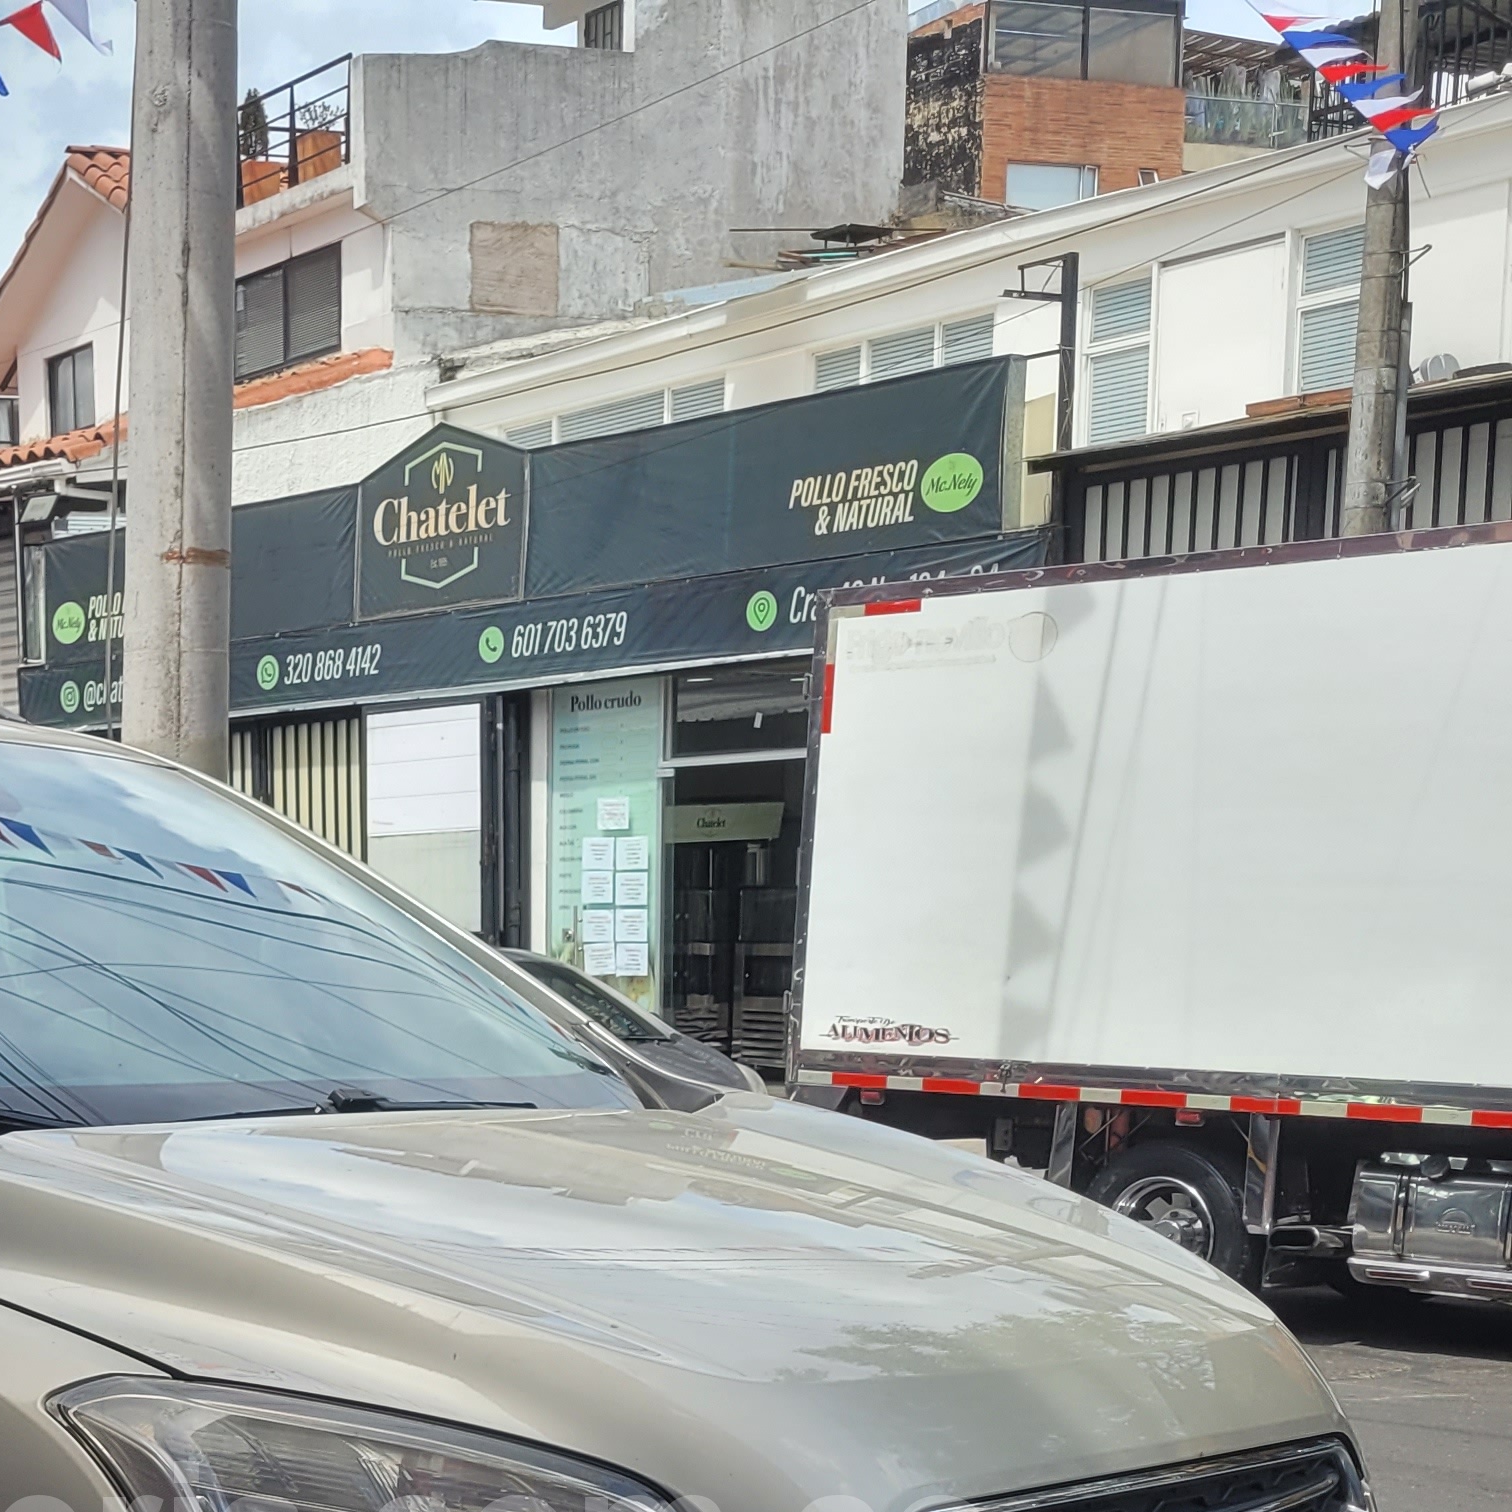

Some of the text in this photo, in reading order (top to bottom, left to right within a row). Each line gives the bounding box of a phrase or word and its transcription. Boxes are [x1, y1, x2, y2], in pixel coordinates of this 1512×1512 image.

[789, 459, 919, 510] POLLO FRESCO
[373, 483, 512, 546] Chatelet
[814, 491, 915, 536] & NATURAL
[88, 618, 99, 642] &
[511, 611, 628, 658] 601 703 6379
[284, 643, 382, 686] 320 868 4142
[570, 690, 642, 712] Pollo crudo
[827, 1022, 951, 1046] ALIMENTOS
